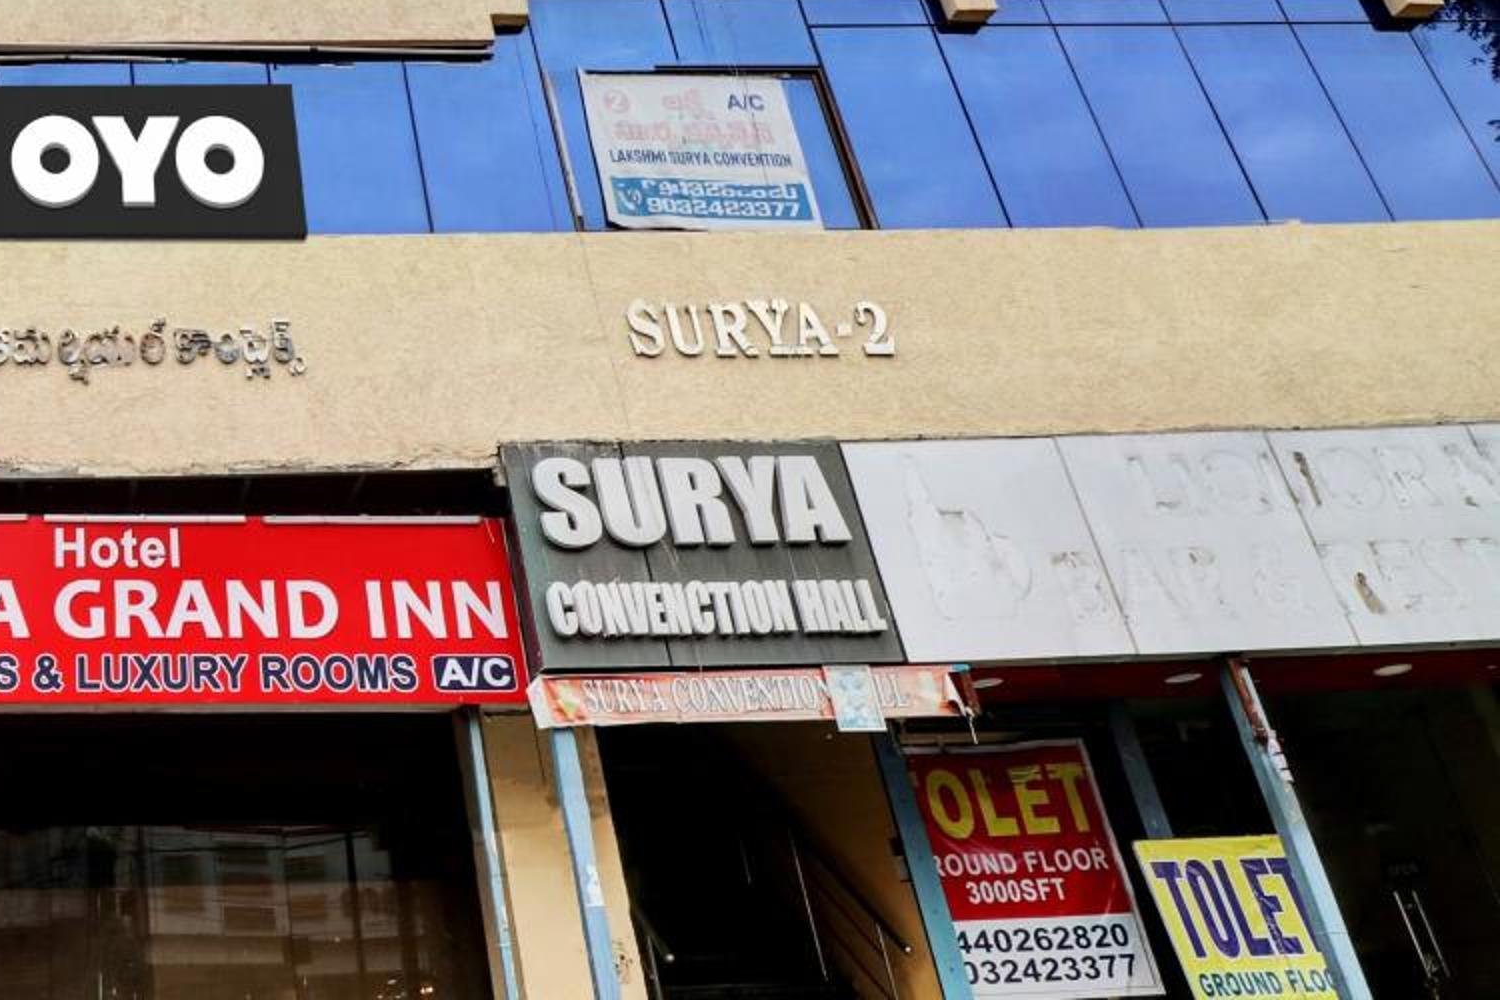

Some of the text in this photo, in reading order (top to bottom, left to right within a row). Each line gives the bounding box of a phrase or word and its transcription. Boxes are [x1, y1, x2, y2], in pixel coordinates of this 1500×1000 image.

[727, 94, 766, 111] A/C
[11, 114, 265, 209] OYO
[608, 148, 793, 169] LAKSHMI SURYA CONVENTION
[646, 197, 799, 217] 9032423377
[626, 300, 895, 357] SURYA-2
[532, 456, 852, 549] SURYA
[54, 527, 181, 570] Hotel
[54, 578, 340, 640] GRAND
[367, 579, 509, 639] INN
[546, 580, 888, 637] CONVENCTION HALL
[32, 653, 64, 692] &
[75, 653, 253, 692] LUXURY
[259, 653, 418, 692] ROOMS
[439, 657, 511, 688] A/C
[581, 679, 669, 713] SURYA
[912, 763, 1092, 840] OLET
[934, 846, 1109, 877] ROUND FLOOR
[966, 878, 1065, 904] 3000SFT
[957, 923, 1129, 954] 440262820
[1199, 969, 1284, 999] GROUND
